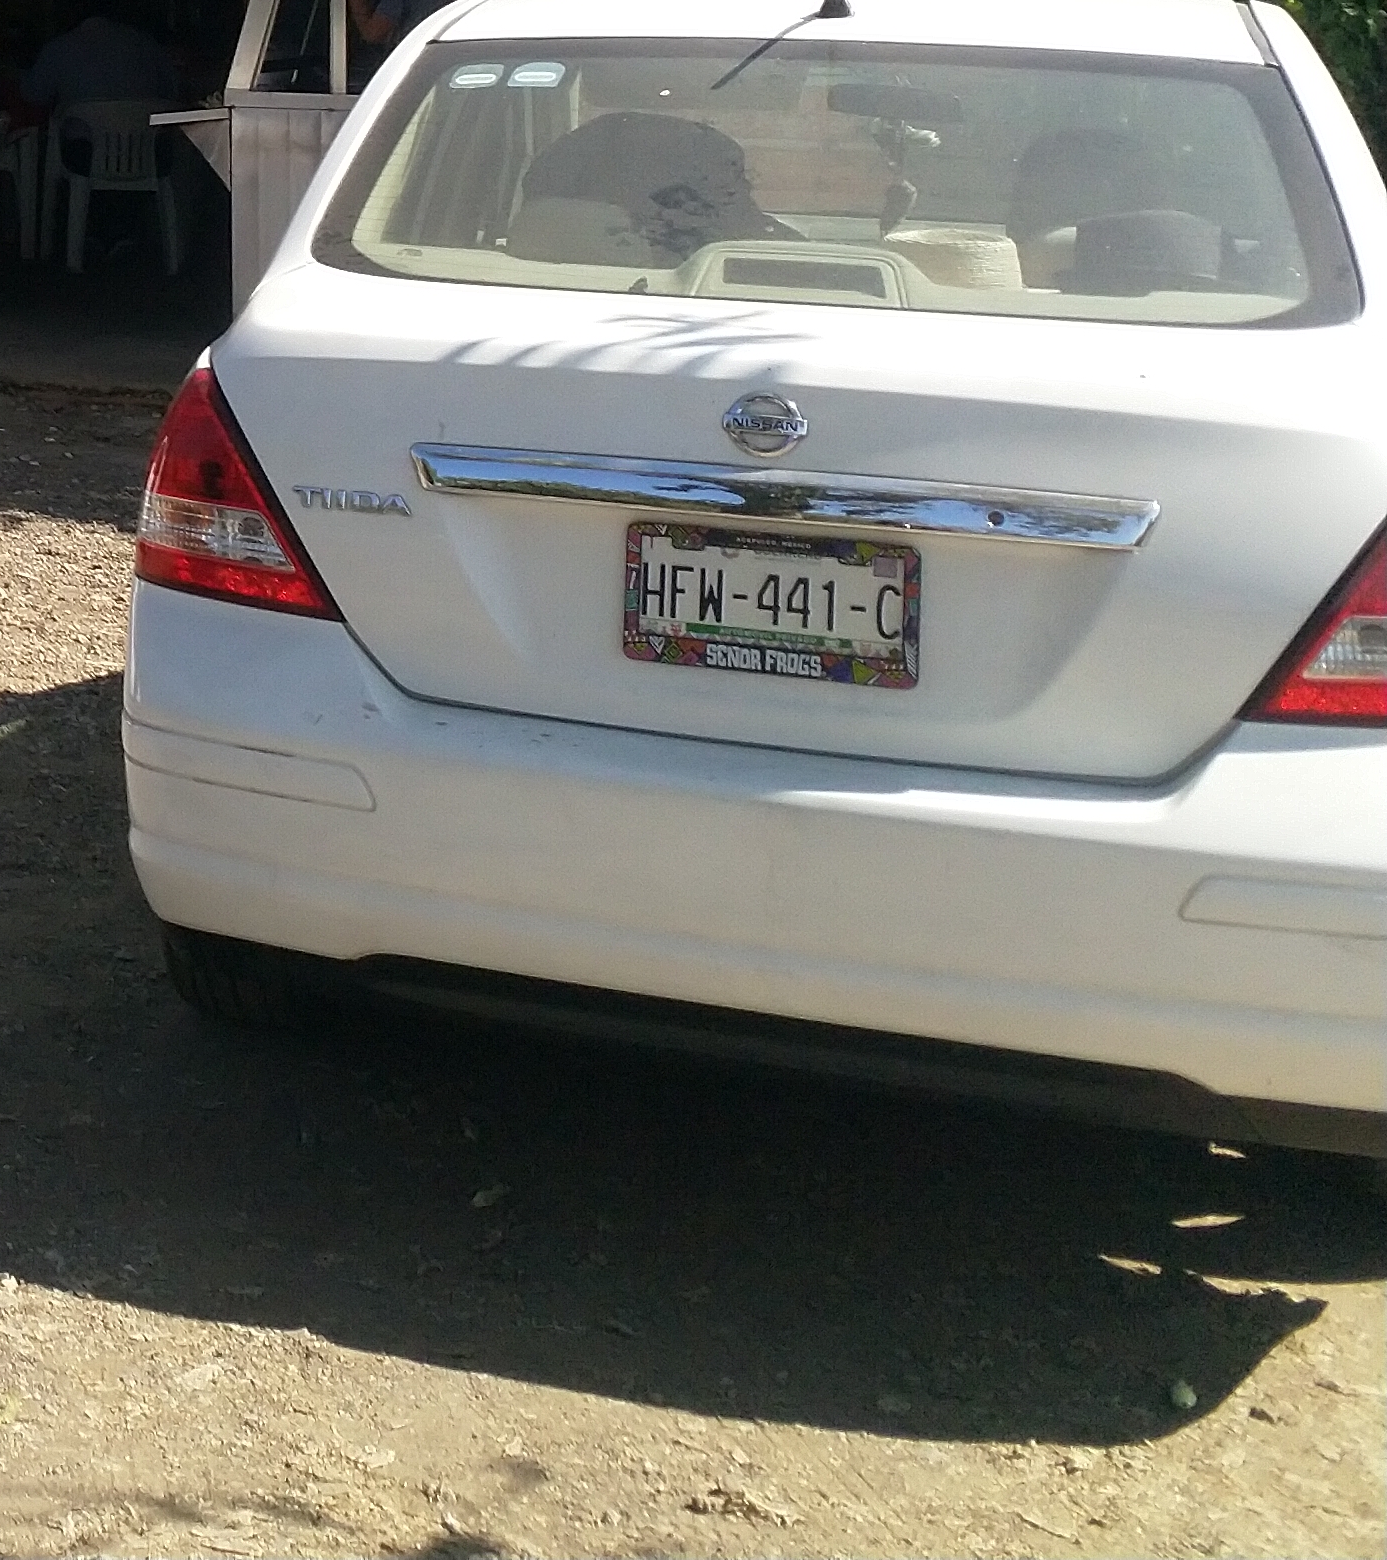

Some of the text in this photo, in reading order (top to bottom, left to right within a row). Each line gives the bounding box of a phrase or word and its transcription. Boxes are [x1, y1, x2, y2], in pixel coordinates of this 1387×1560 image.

[732, 417, 798, 432] NISSAN
[293, 485, 412, 516] TIIDA
[640, 562, 903, 640] HFW-441-C
